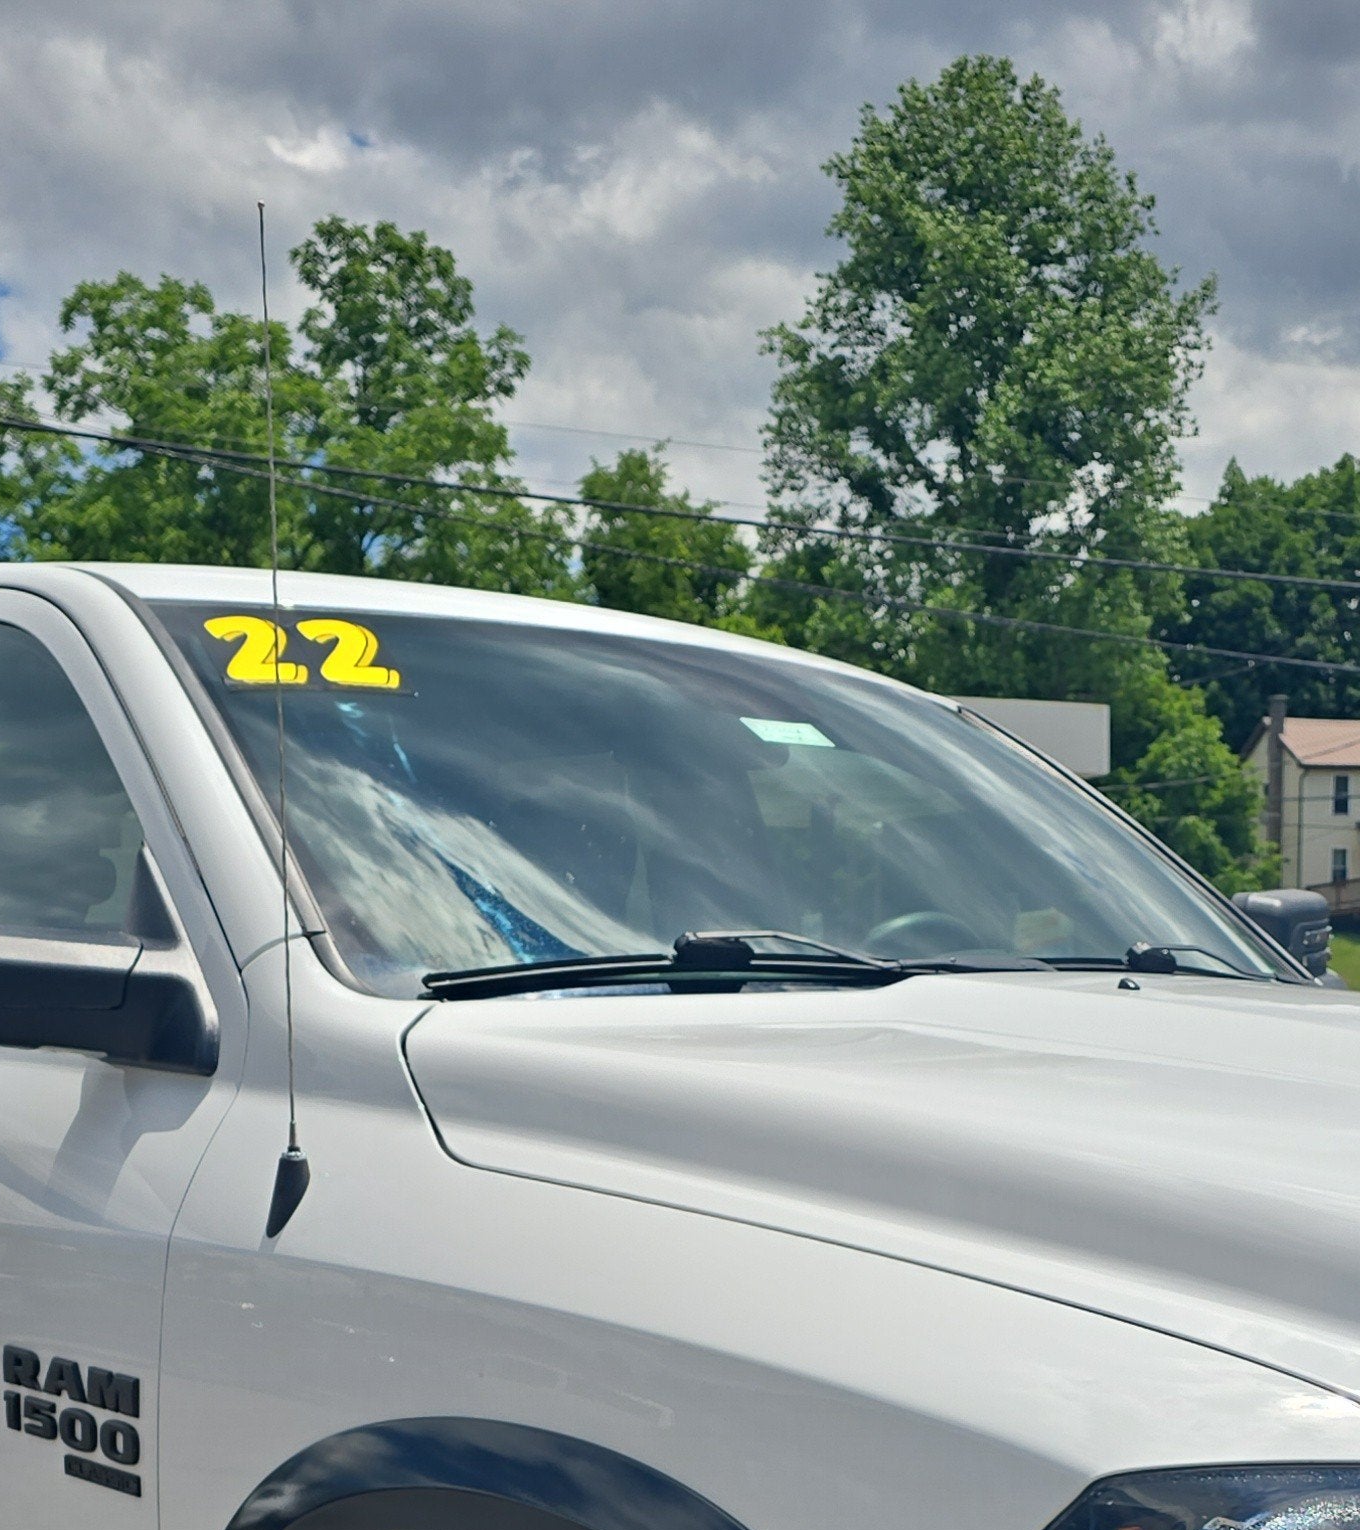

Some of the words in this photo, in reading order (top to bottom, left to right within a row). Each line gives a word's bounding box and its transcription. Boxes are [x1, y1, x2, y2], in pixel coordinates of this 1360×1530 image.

[203, 615, 400, 689] 22
[2, 1344, 140, 1419] RAM
[3, 1390, 140, 1465] 1500
